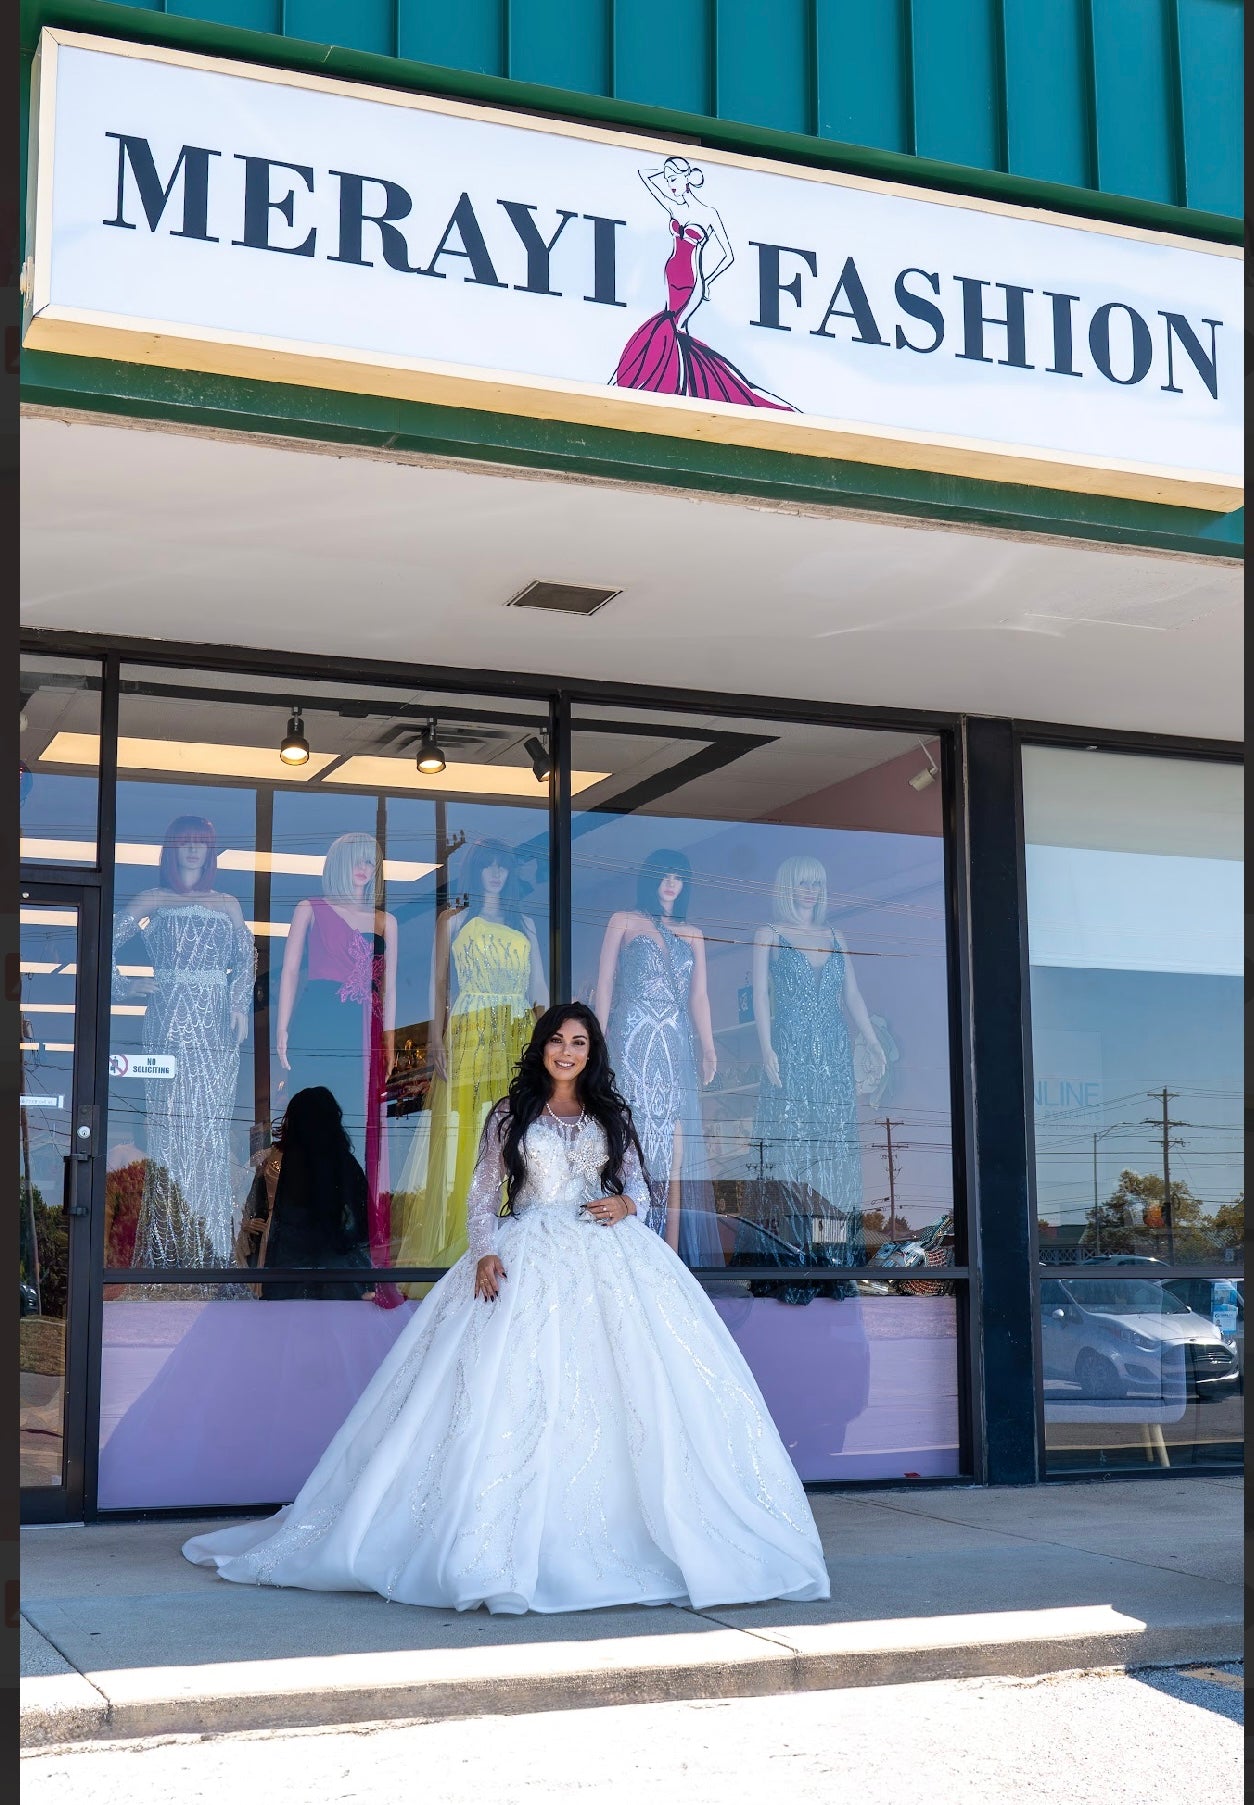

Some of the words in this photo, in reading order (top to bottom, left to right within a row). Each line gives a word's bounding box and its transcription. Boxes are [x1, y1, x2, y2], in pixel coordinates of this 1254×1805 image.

[103, 131, 628, 308] MERAYI
[748, 240, 1225, 401] FASHION
[147, 1057, 156, 1066] NO
[132, 1065, 170, 1074] SOLICITING
